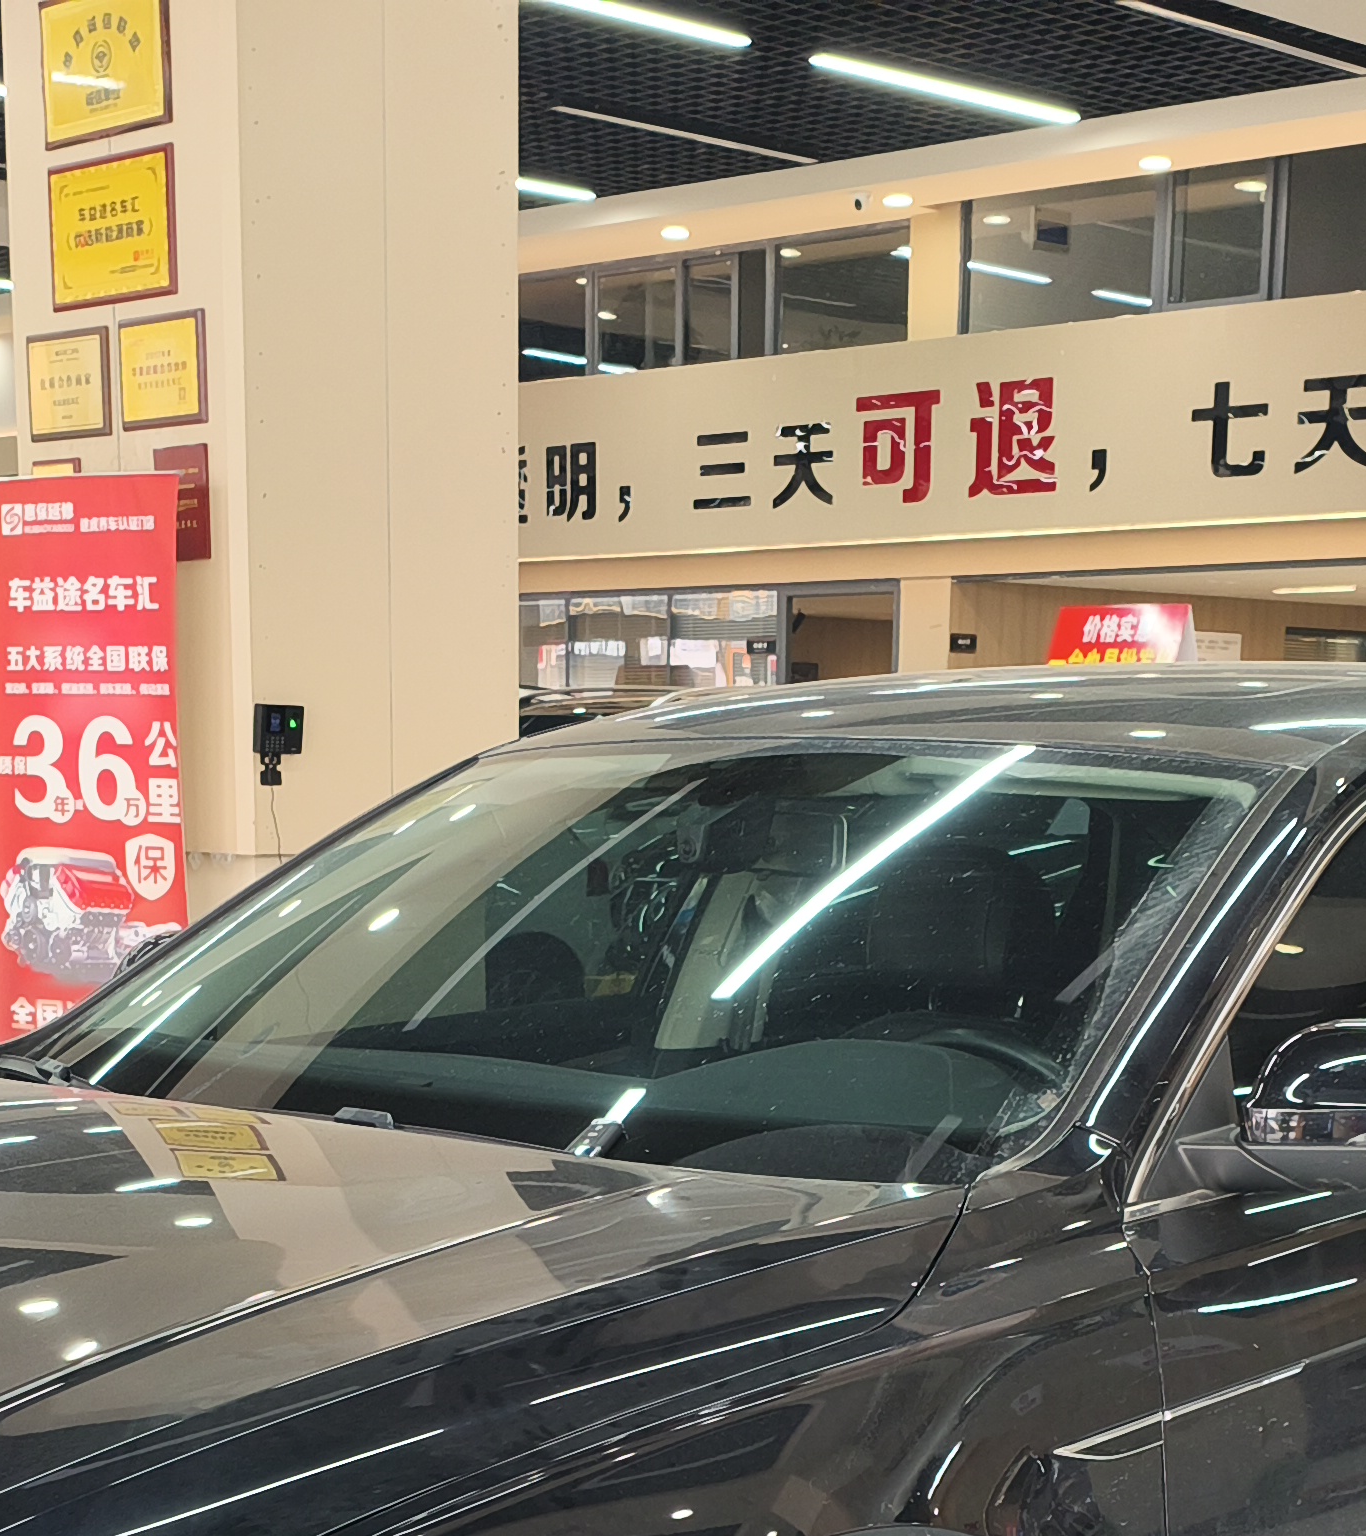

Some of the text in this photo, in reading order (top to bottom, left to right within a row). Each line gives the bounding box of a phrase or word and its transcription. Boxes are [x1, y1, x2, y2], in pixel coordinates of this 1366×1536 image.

[518, 442, 631, 523] 明，
[693, 377, 1107, 510] 三天可退，
[8, 575, 160, 613] 车益途名车汇
[6, 645, 169, 672] 五大系统全国联保
[144, 721, 181, 824] 公里
[134, 845, 168, 885] 保
[10, 997, 75, 1031] 全国
